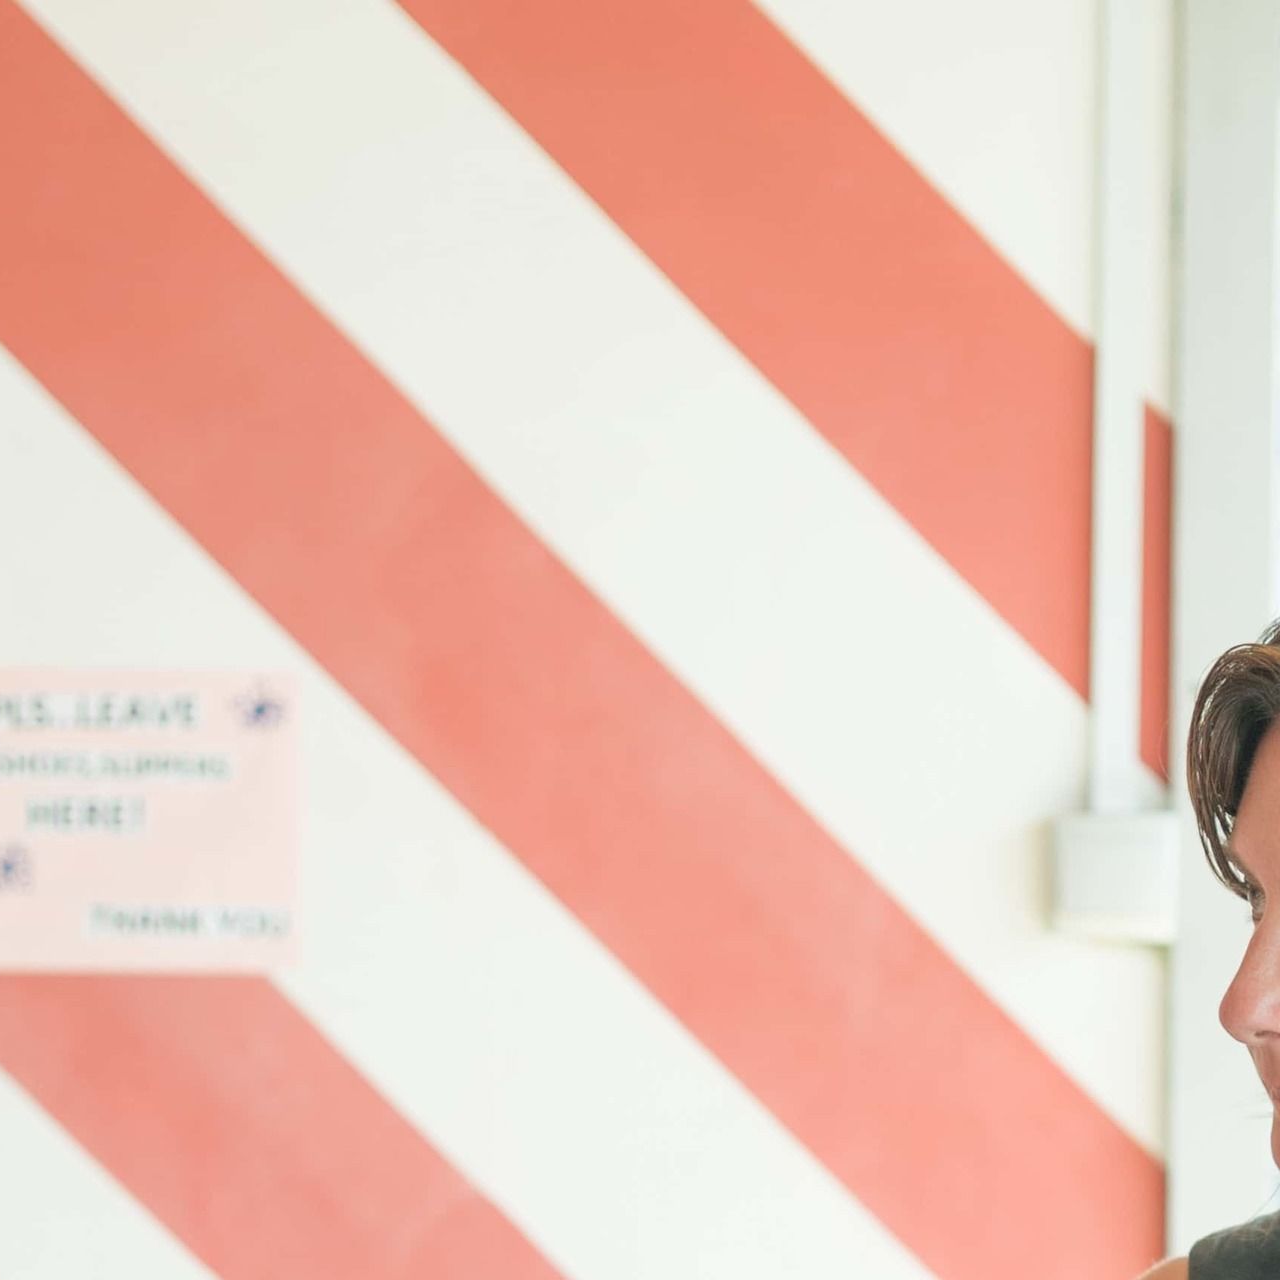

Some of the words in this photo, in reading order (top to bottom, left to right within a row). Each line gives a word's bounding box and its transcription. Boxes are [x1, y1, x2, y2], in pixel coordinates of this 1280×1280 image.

[75, 694, 197, 730] LEAVE
[24, 798, 146, 829] HERE!
[90, 904, 200, 935] THANK
[219, 907, 288, 938] YOU
